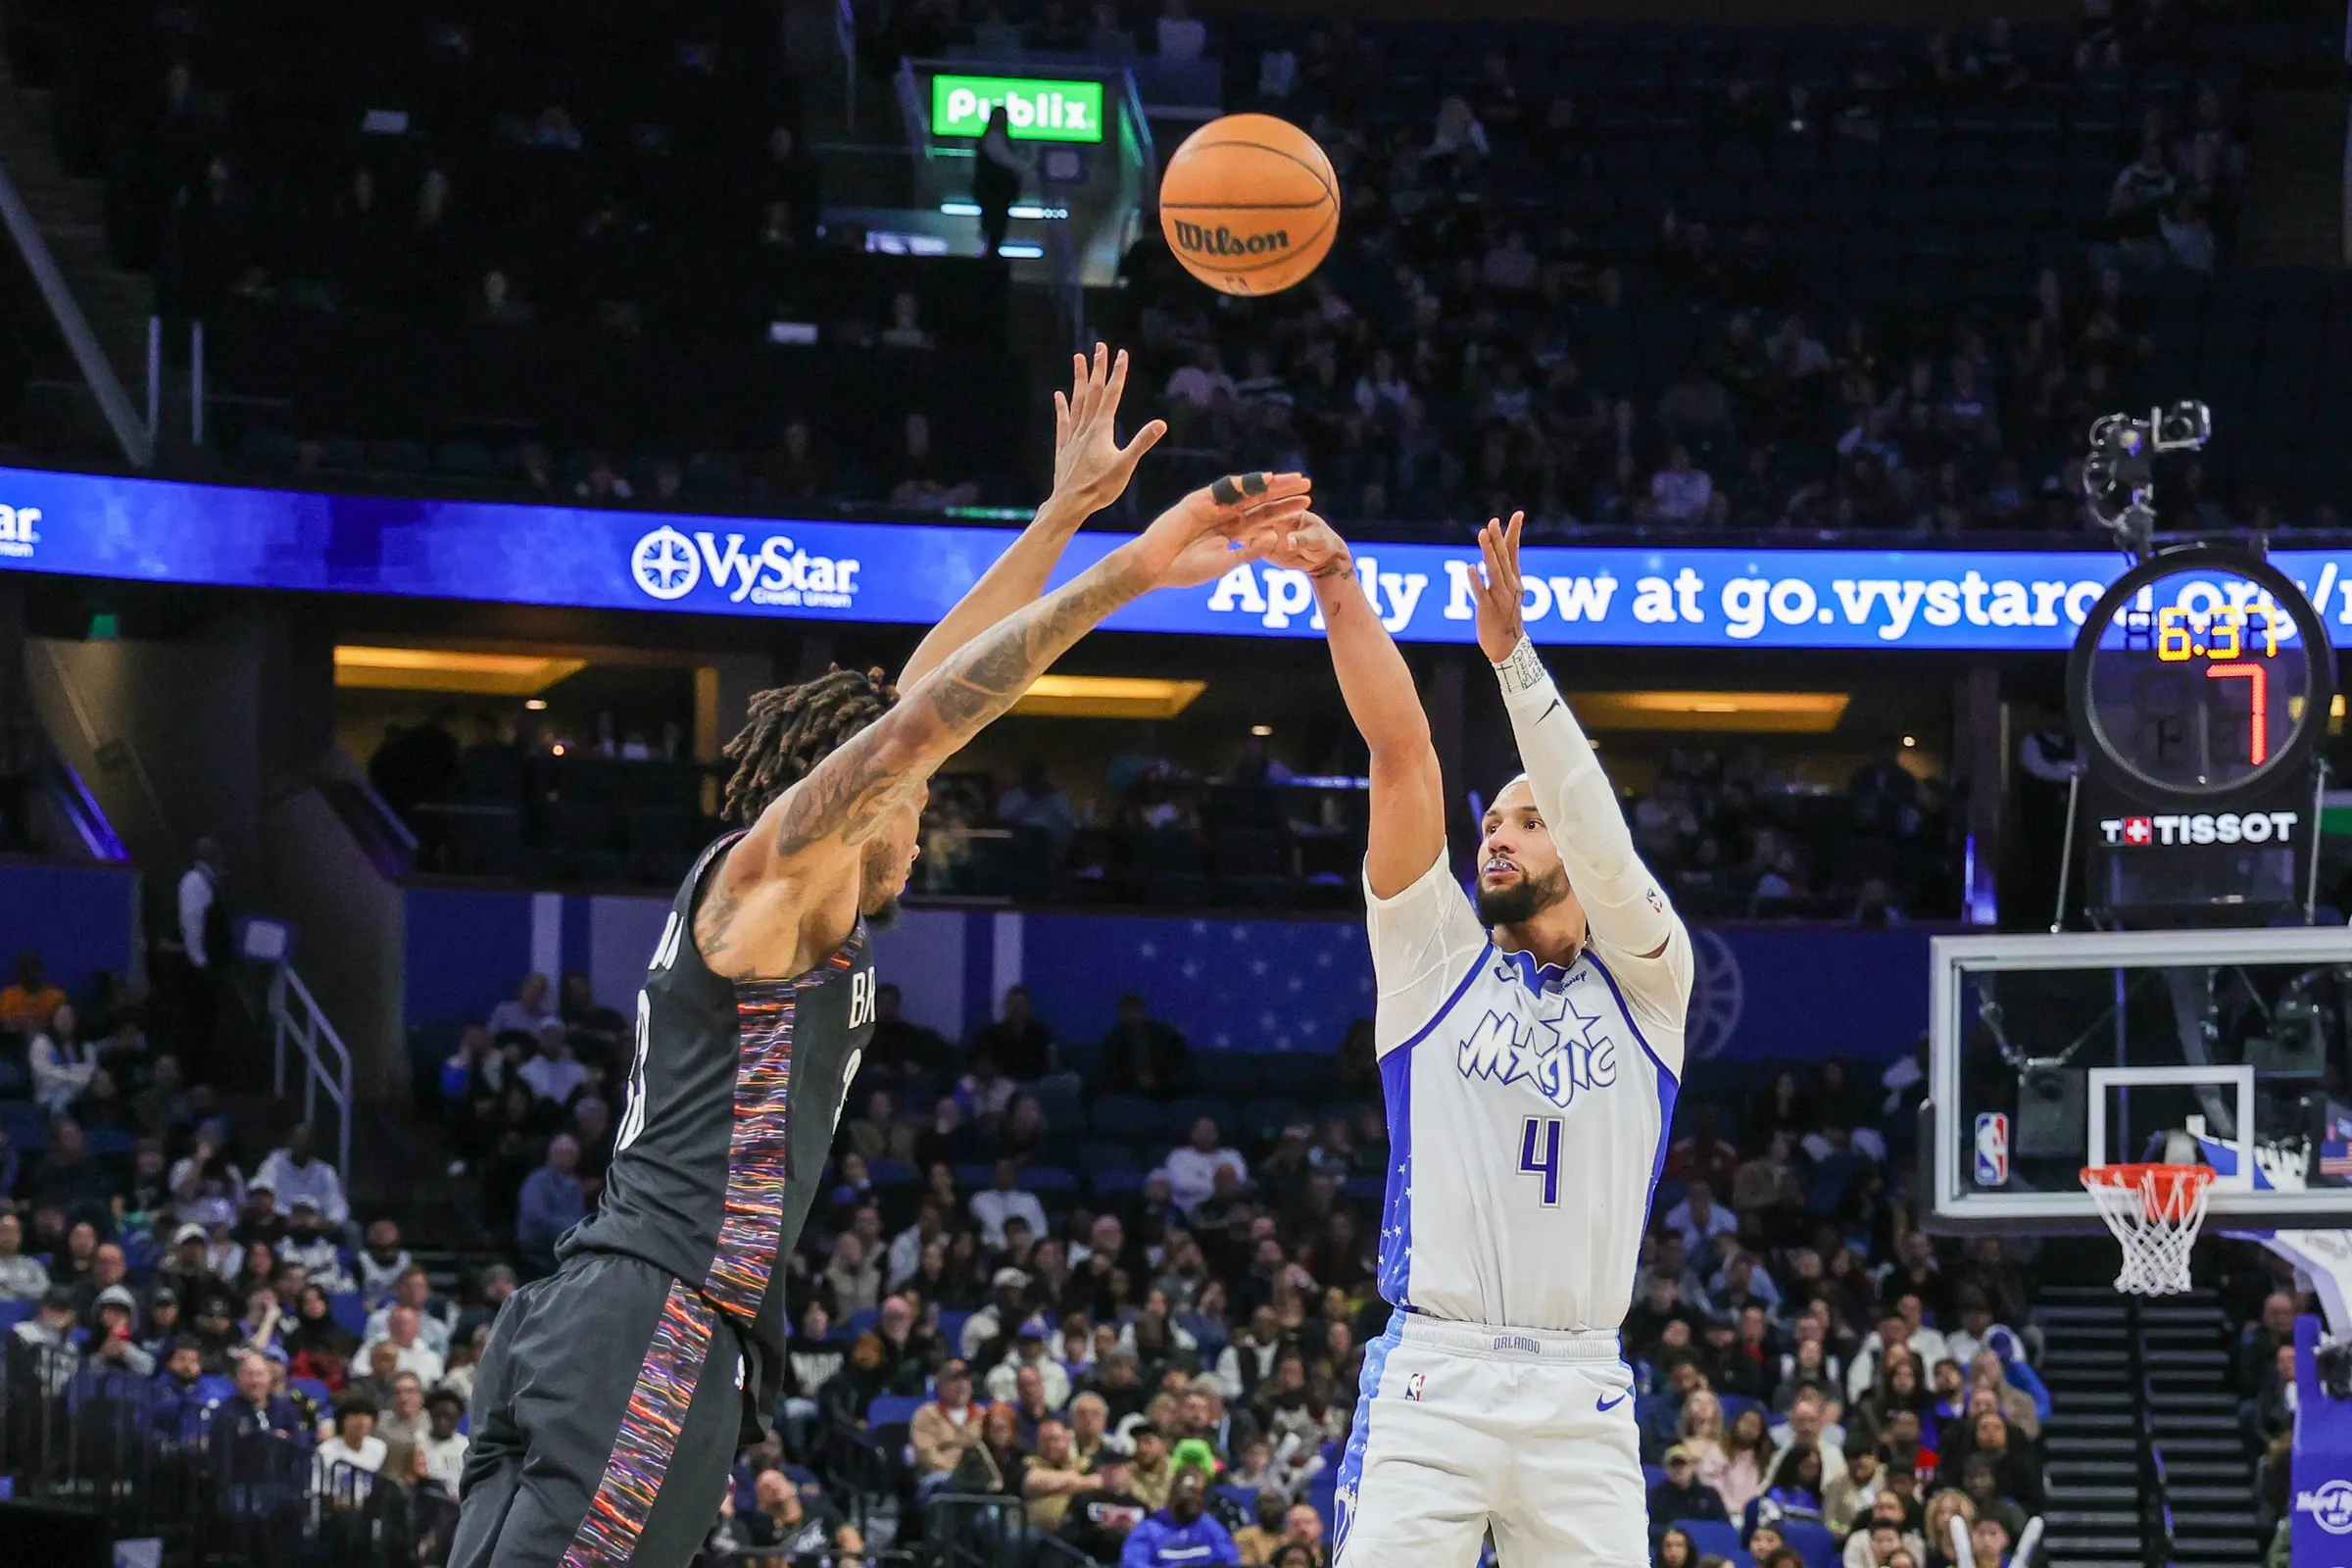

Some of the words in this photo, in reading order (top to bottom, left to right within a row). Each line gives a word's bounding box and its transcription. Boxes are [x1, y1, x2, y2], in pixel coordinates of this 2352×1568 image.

[1174, 219, 1290, 257] Wilson
[694, 532, 859, 603] VyStar
[1632, 567, 1705, 623] at
[2158, 607, 2278, 662] 6:37
[2206, 662, 2266, 765] 7
[2153, 811, 2298, 845] TISSOT
[1515, 1113, 1565, 1208] 4
[1494, 1336, 1541, 1354] ORLANDO
